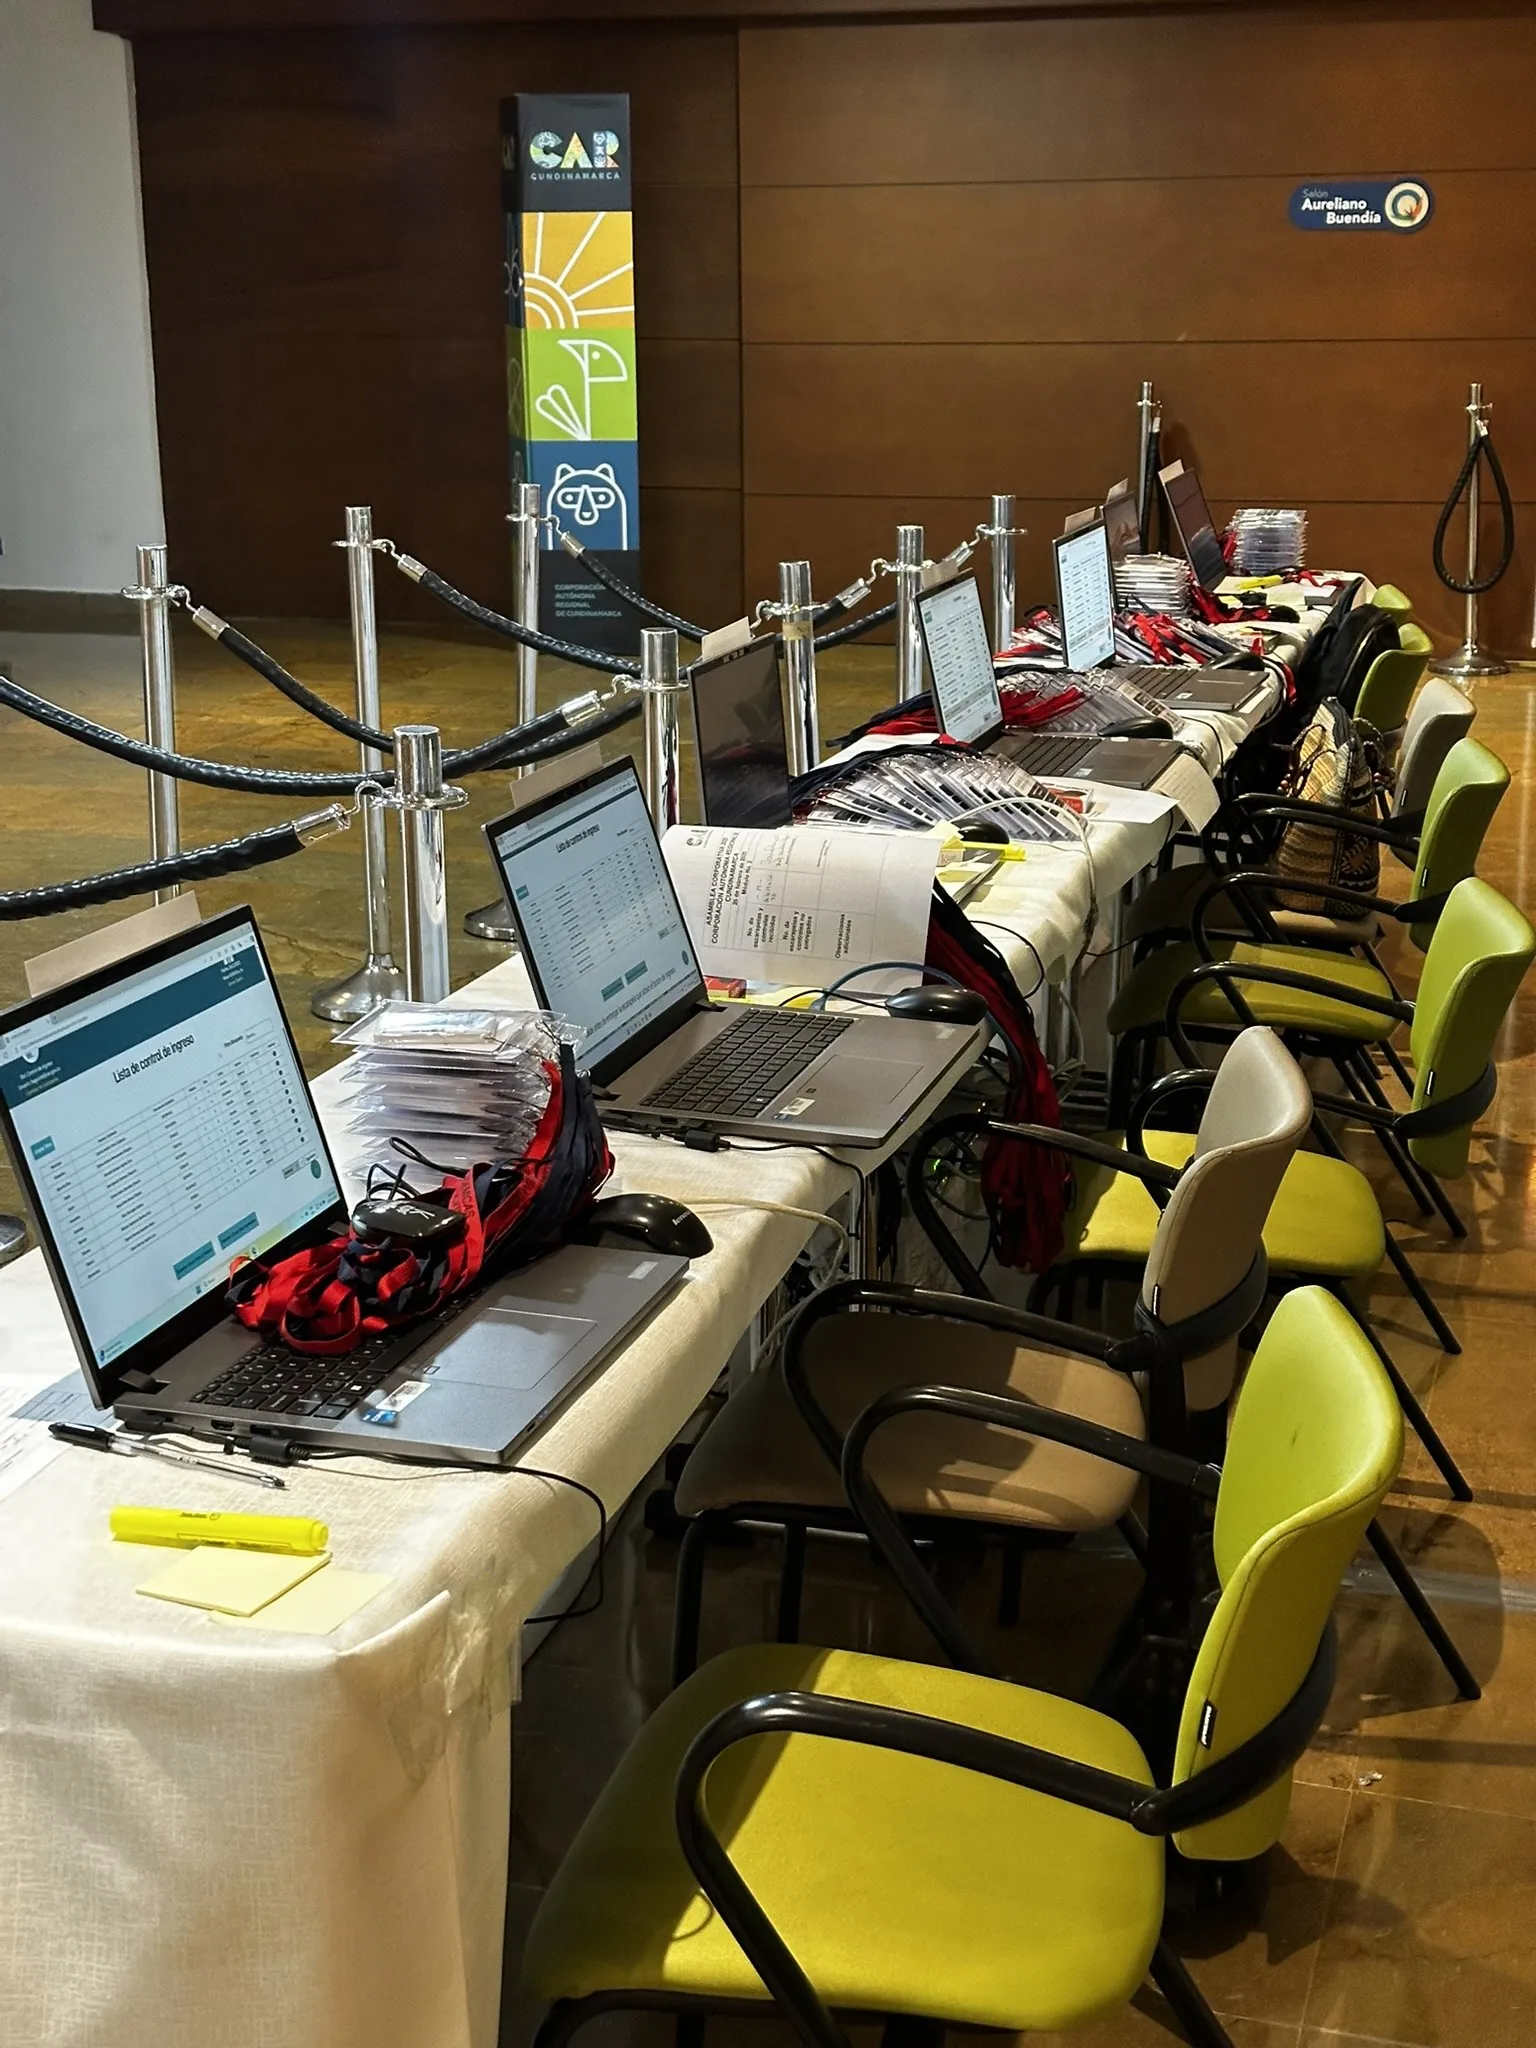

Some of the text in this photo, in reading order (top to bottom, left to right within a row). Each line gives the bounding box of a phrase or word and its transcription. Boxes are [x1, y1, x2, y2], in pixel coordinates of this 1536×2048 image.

[530, 131, 620, 169] CAR
[531, 172, 620, 180] CUNDINAMARCA
[1301, 197, 1367, 211] Aureliano
[1326, 210, 1381, 224] Buendía
[725, 853, 739, 902] CUNDINAMARCA
[706, 888, 716, 925] ASAMBLEA
[712, 892, 724, 943] CORPORACIÓN
[719, 856, 730, 891] AUTÓNOMA
[835, 914, 845, 958] Observaciones
[112, 1034, 194, 1083] Lista de control de ingreso
